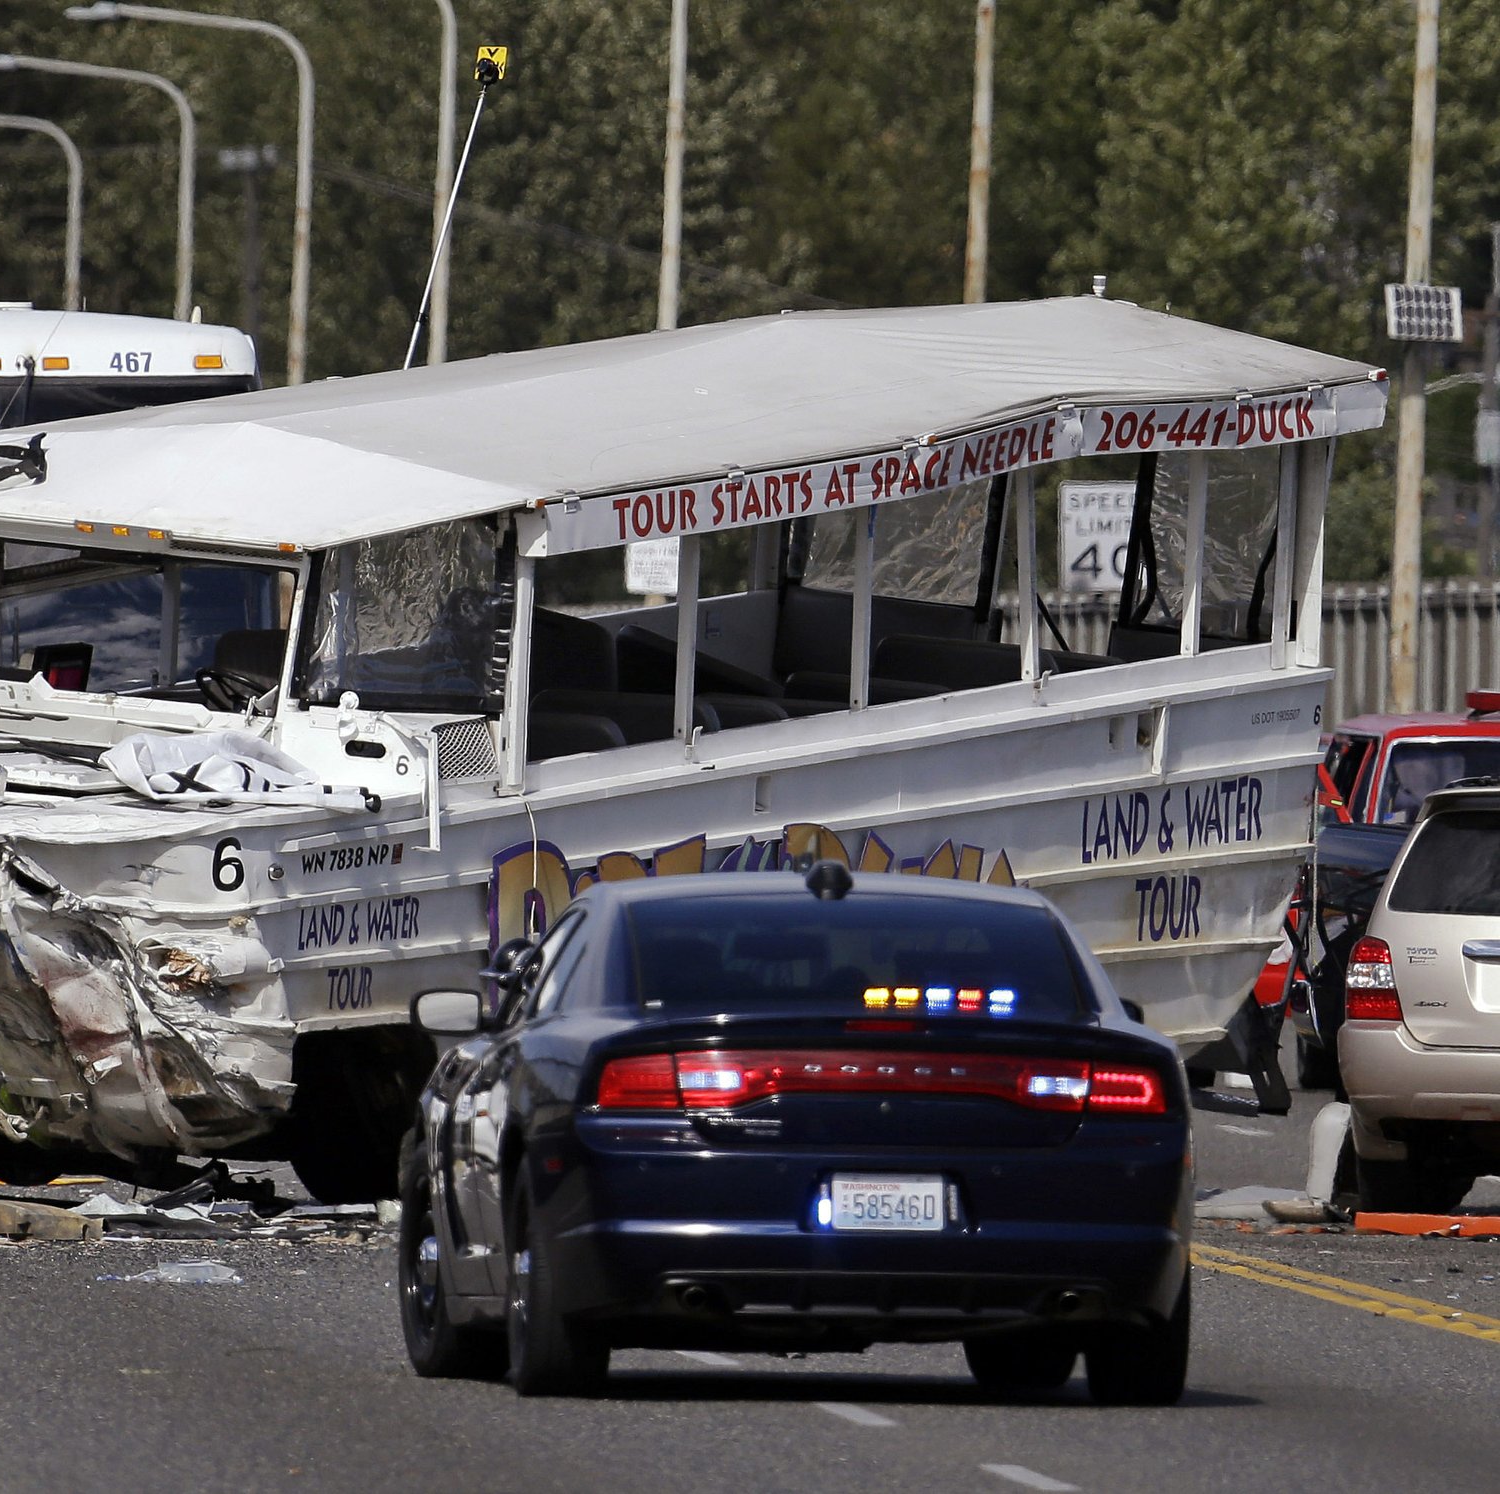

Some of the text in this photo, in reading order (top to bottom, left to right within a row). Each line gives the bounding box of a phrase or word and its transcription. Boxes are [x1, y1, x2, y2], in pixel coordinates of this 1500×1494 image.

[110, 352, 152, 373] 467
[1095, 394, 1315, 452] 206-441-DUCK
[613, 418, 1056, 540] TOUR STARTS AT SPACE NEEDLE
[1070, 493, 1135, 512] SPEE
[1251, 712, 1260, 725] US
[1261, 711, 1275, 724] DOT
[1313, 704, 1322, 725] 6
[396, 755, 410, 776] 6
[1081, 791, 1150, 864] LAND
[1157, 788, 1174, 854] &
[1184, 775, 1262, 851] WATER
[211, 836, 245, 892] 6
[302, 844, 389, 875] WN 7838 NP
[297, 895, 420, 951] LAND & WATER
[1135, 875, 1201, 942] TOUR
[327, 966, 372, 1011] TOUR
[842, 1183, 901, 1191] WASHINGTON
